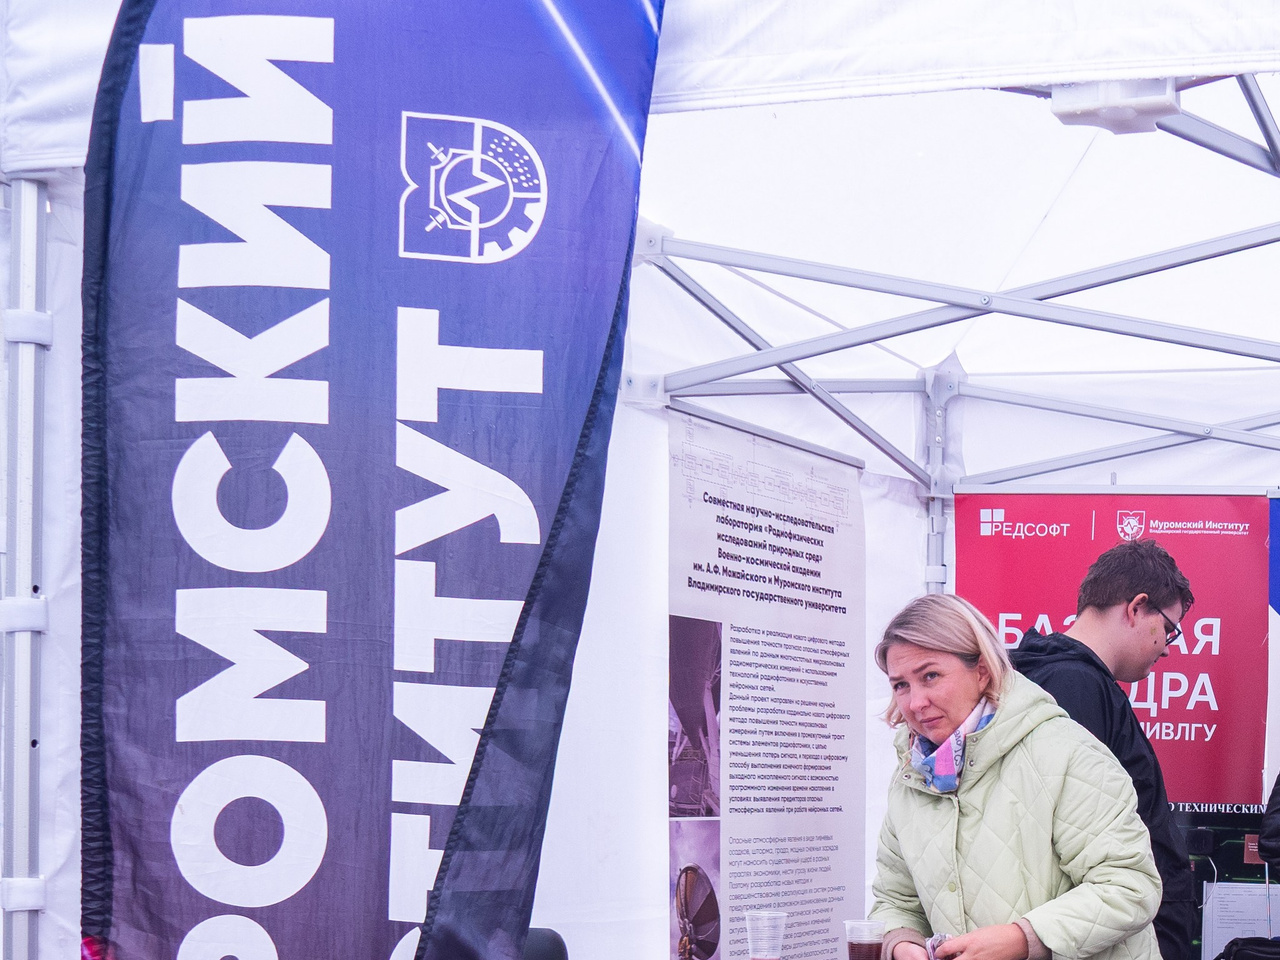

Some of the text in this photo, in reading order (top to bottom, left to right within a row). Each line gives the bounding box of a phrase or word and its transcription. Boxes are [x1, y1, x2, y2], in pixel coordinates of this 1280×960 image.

[703, 491, 835, 534] Совместная научно-исследовательская
[1149, 519, 1250, 532] Муромский Институт
[716, 514, 824, 547] лаборатория «Радиофизических
[992, 522, 1071, 540] РЕДСОФТ
[716, 532, 823, 563] исследований природных сред»
[718, 547, 821, 579] Военно-космической академии
[688, 576, 847, 614] Владимирского государственного университета
[693, 562, 705, 572] им.
[706, 562, 721, 575] А.Ф.
[722, 565, 767, 583] Можайского
[773, 575, 811, 592] Муромского
[812, 585, 842, 599] института
